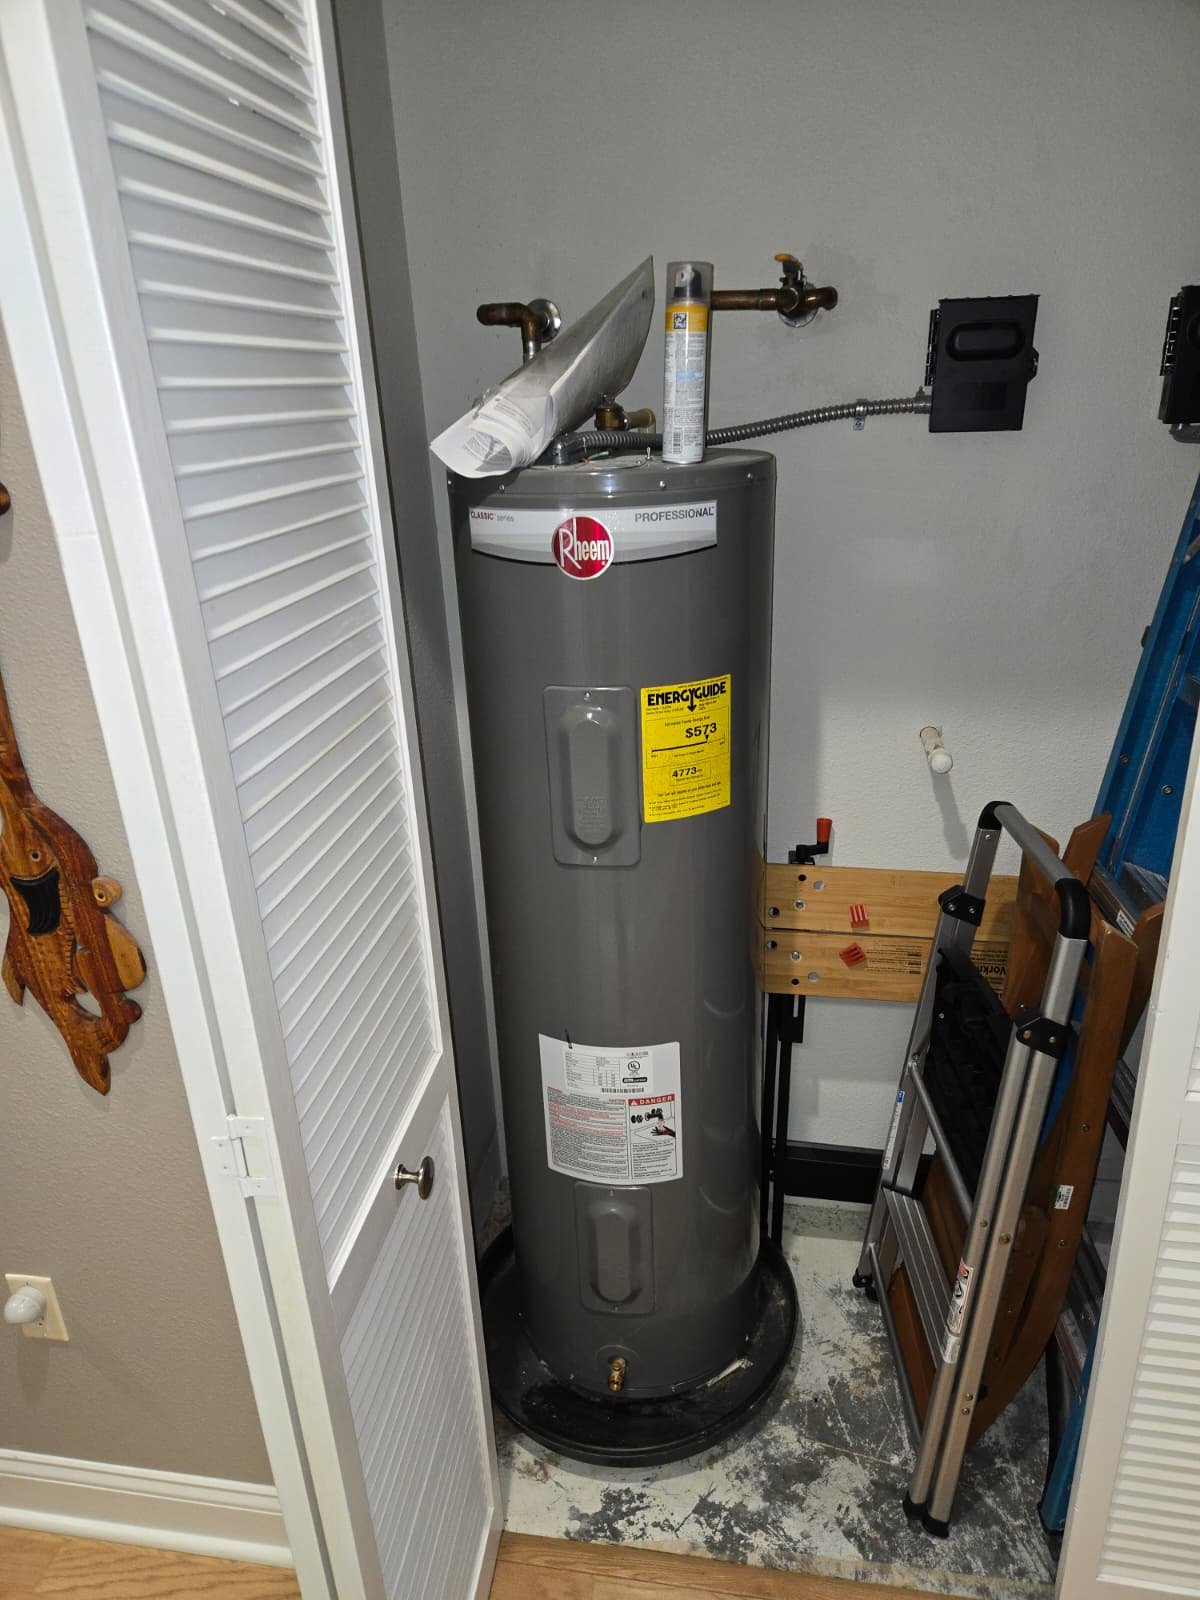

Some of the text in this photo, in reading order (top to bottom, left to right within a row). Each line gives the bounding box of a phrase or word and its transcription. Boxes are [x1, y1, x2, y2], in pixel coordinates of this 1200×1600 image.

[470, 511, 494, 521] CLASSIC
[634, 506, 714, 523] PROFESSIONAL
[559, 516, 610, 570] Rheem
[647, 681, 727, 707] ENERGYGUIDE
[685, 722, 717, 739] $573
[672, 767, 697, 778] 4773
[639, 1095, 673, 1105] DANGER
